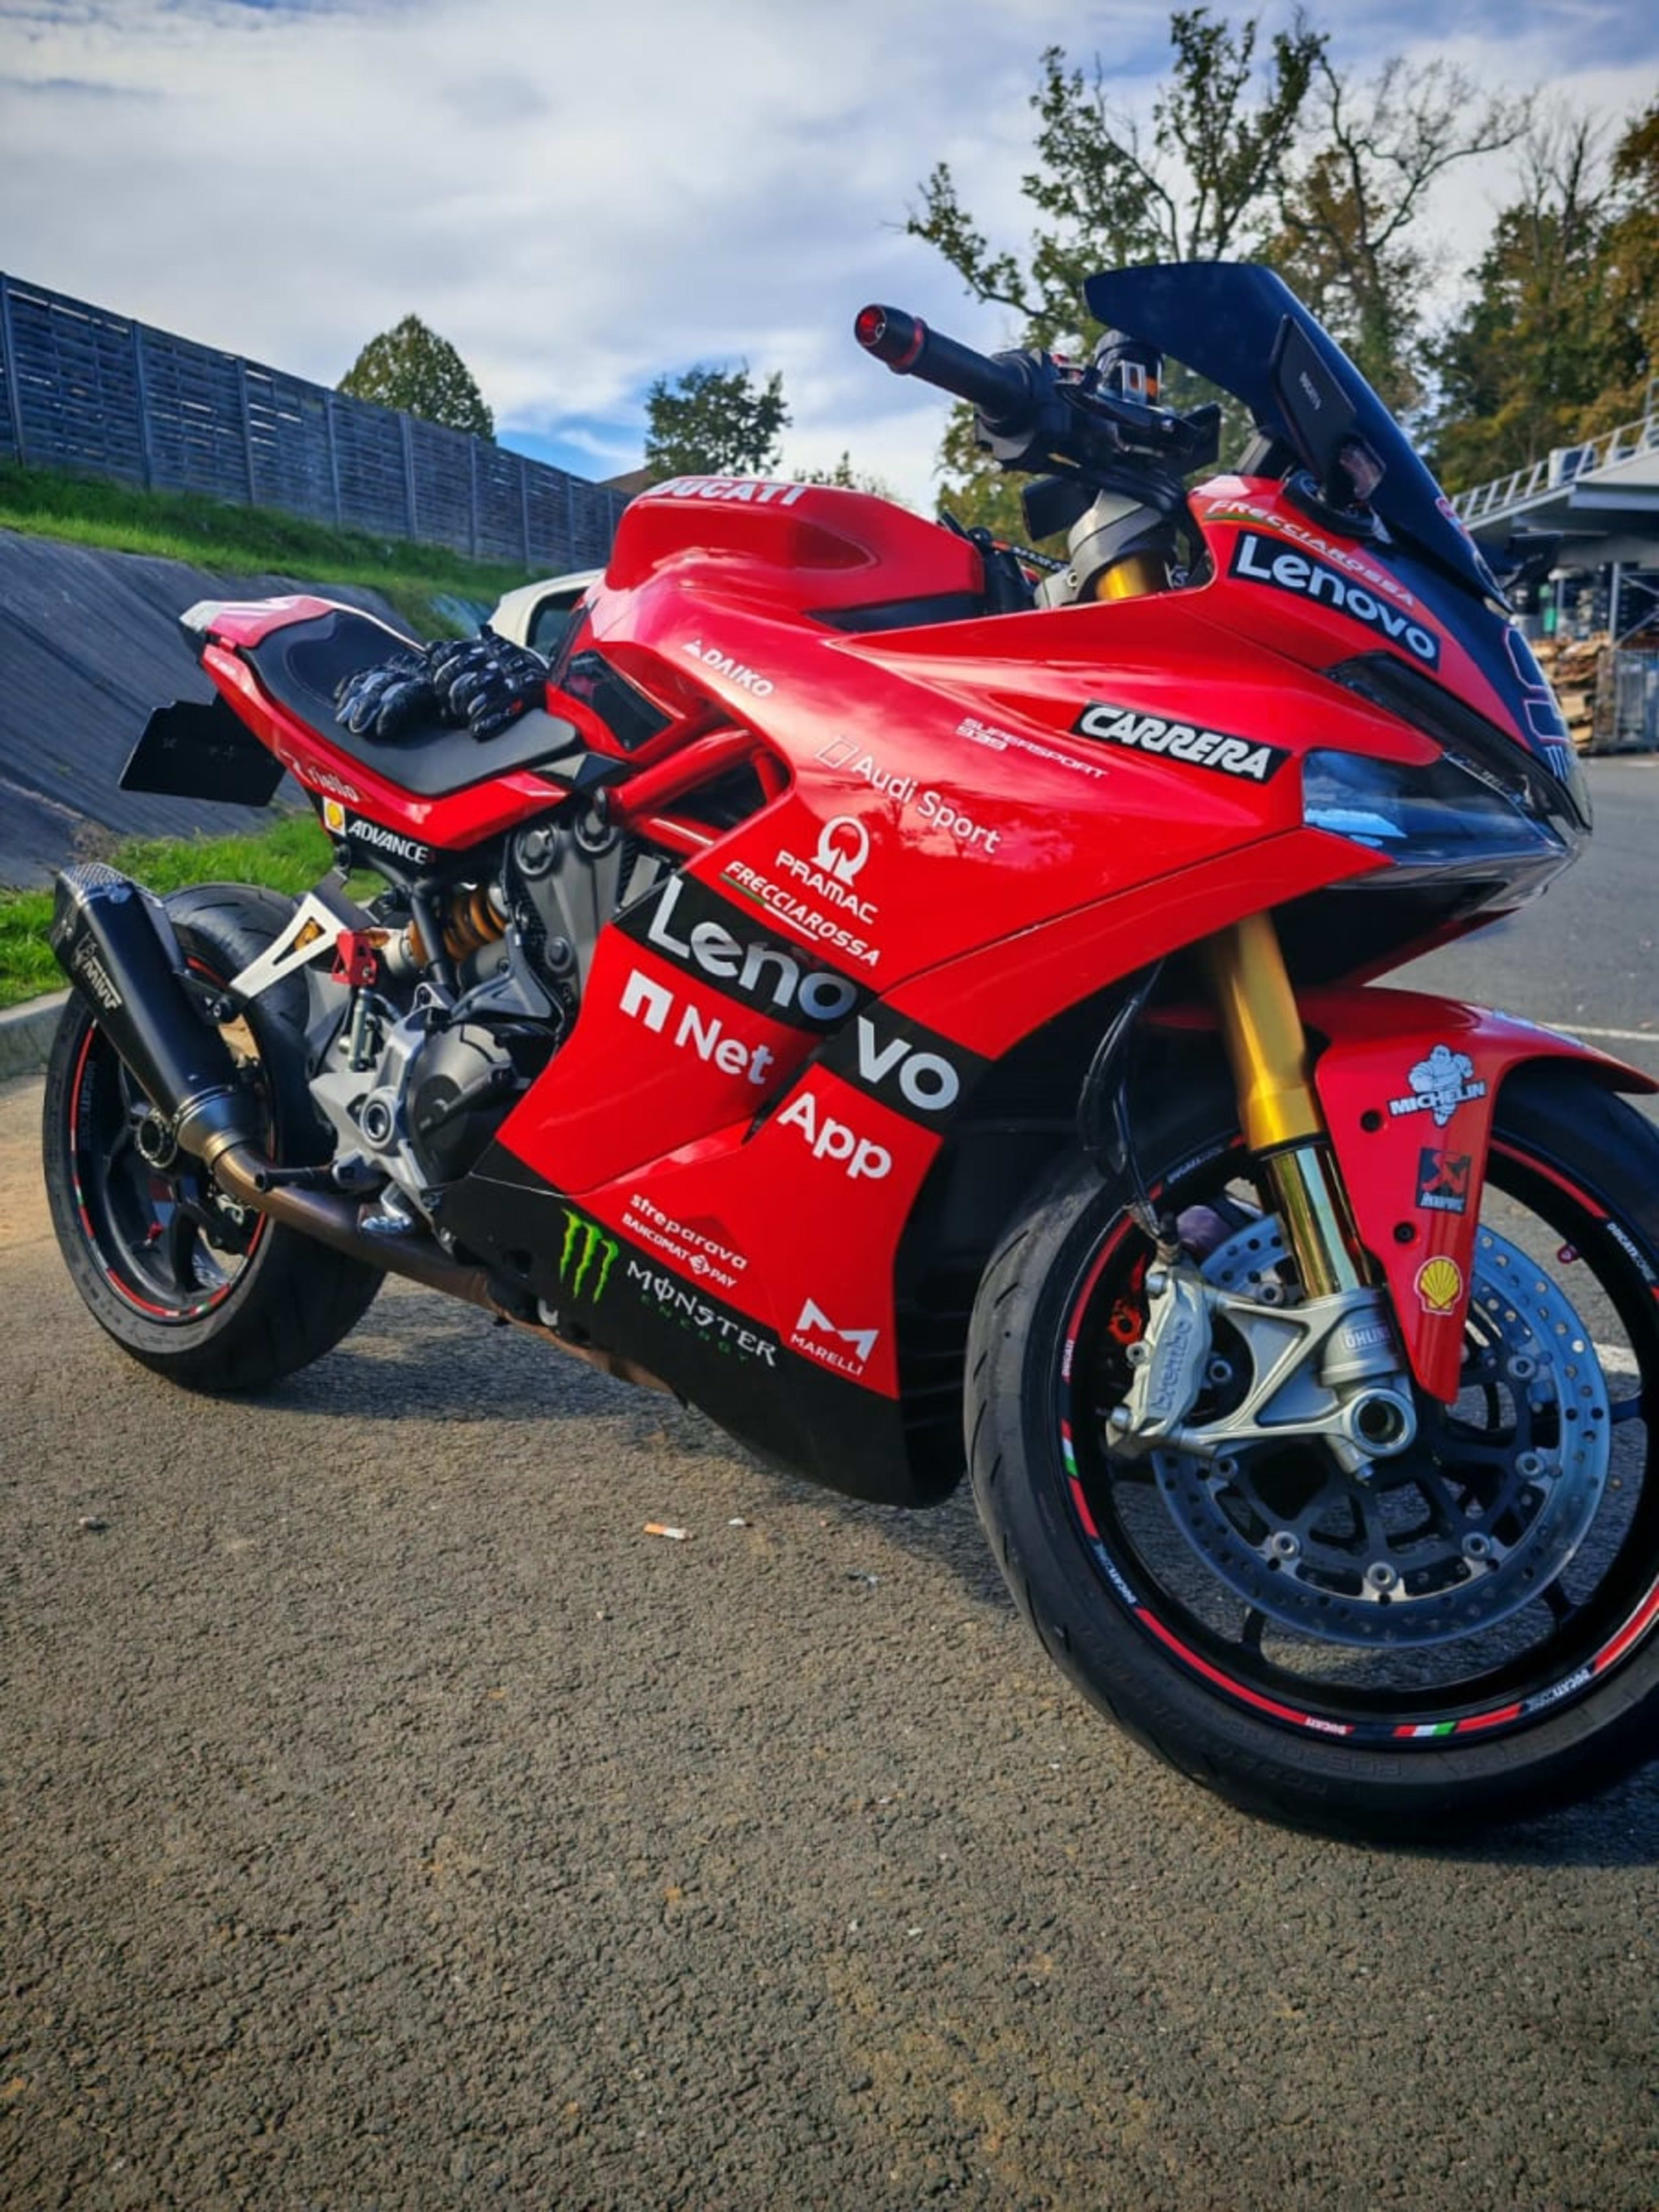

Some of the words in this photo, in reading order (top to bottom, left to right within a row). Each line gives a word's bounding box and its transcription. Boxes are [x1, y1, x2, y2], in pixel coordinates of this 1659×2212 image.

[648, 479, 807, 506] DUCATI
[1236, 534, 1437, 660] Lenovo
[699, 648, 775, 697] DAIKO
[1080, 706, 1274, 780] CARRERA
[852, 755, 918, 803] Audi
[917, 790, 1002, 854] Sport
[347, 819, 429, 865] ADVANCE
[725, 860, 881, 968] FRECCIAROSSA
[775, 850, 879, 925] PRAMAC
[1390, 1082, 1486, 1116] MICHELIN
[621, 1212, 690, 1260] BANCOMAT
[630, 1194, 748, 1270] streparava
[626, 1260, 776, 1367] MONSTER
[789, 1333, 864, 1376] MARELLI
[1149, 1317, 1193, 1412] brembo
